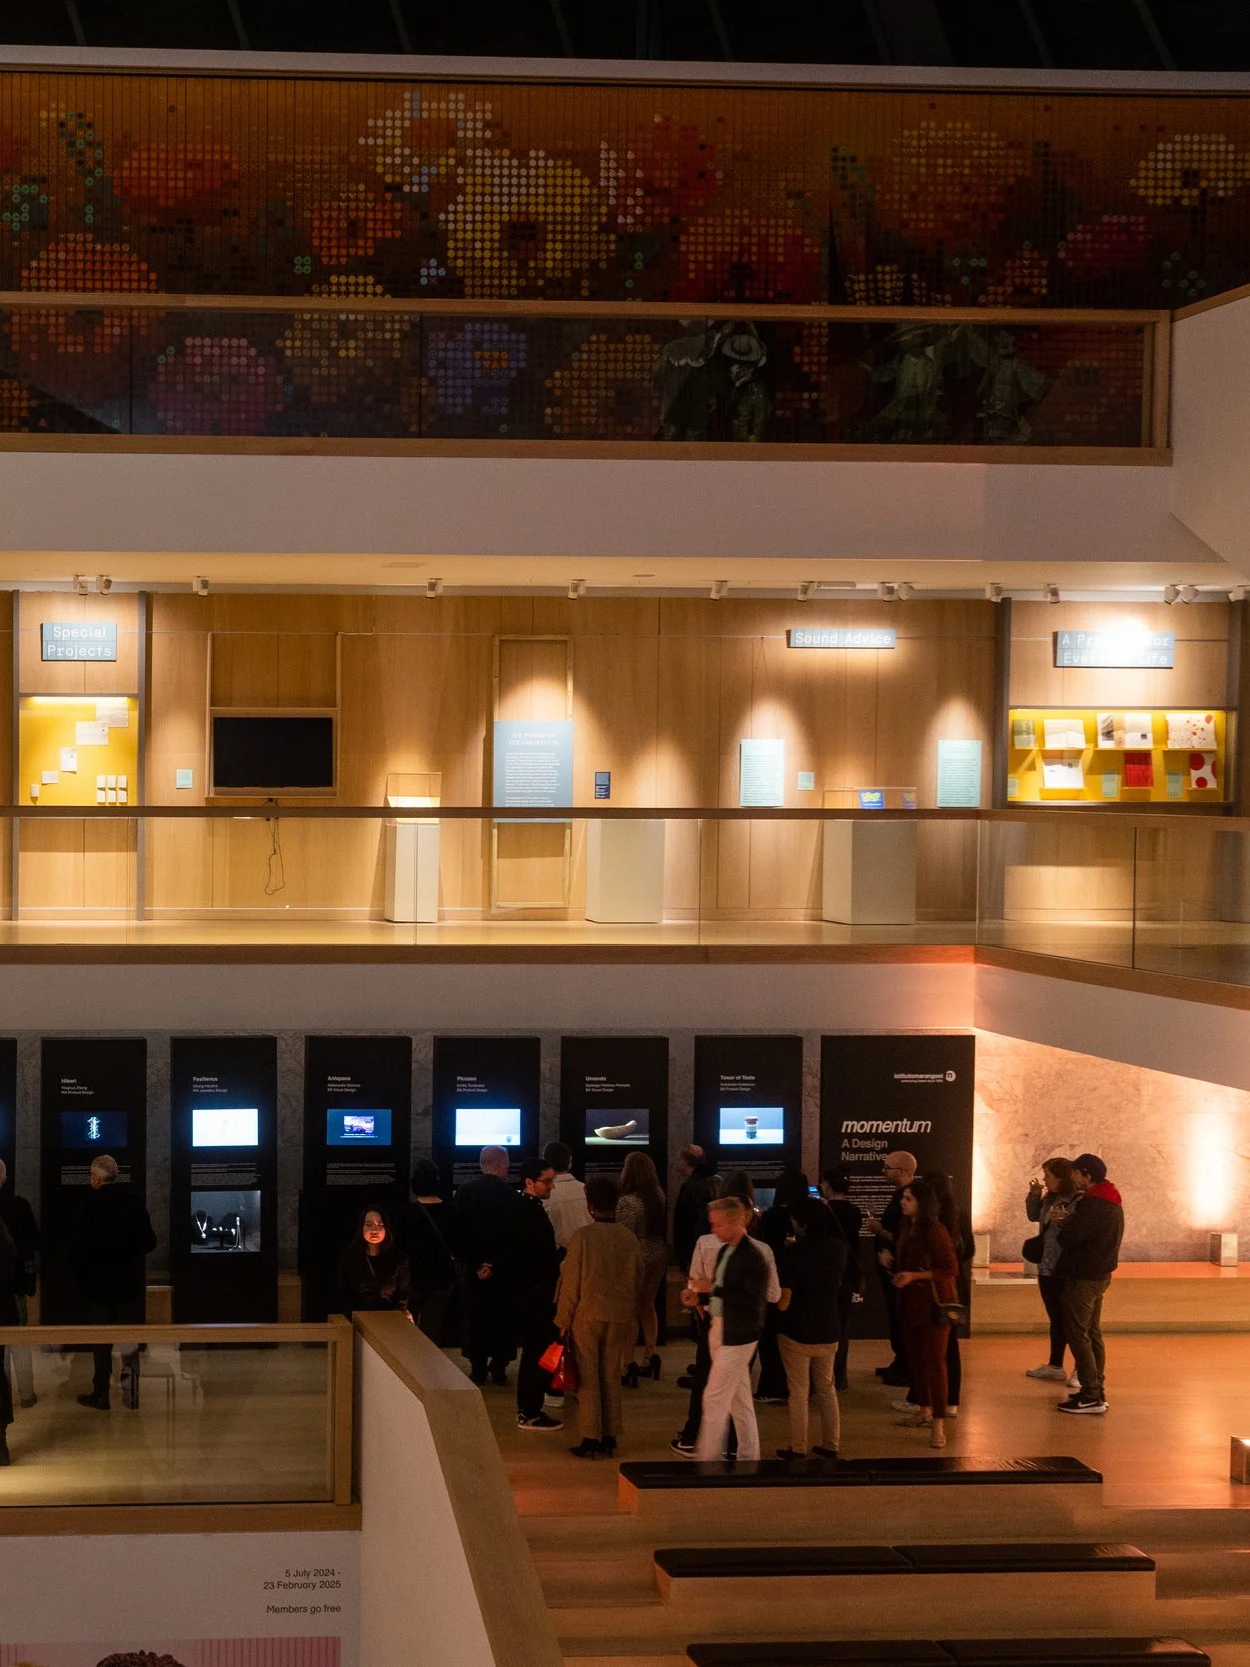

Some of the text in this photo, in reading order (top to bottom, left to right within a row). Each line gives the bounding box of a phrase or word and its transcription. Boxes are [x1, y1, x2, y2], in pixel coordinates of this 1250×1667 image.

[53, 626, 106, 640] Special
[795, 631, 891, 644] Sound Advice
[1062, 634, 1071, 645] A
[47, 644, 111, 659] Projects
[841, 1118, 932, 1133] momentum
[841, 1138, 888, 1150] A Design
[841, 1151, 888, 1161] Narrative
[285, 1569, 291, 1577] 5
[293, 1569, 311, 1579] July
[313, 1568, 335, 1577] 2024
[263, 1580, 341, 1591] 23 February 2025
[266, 1604, 341, 1615] Members go free
